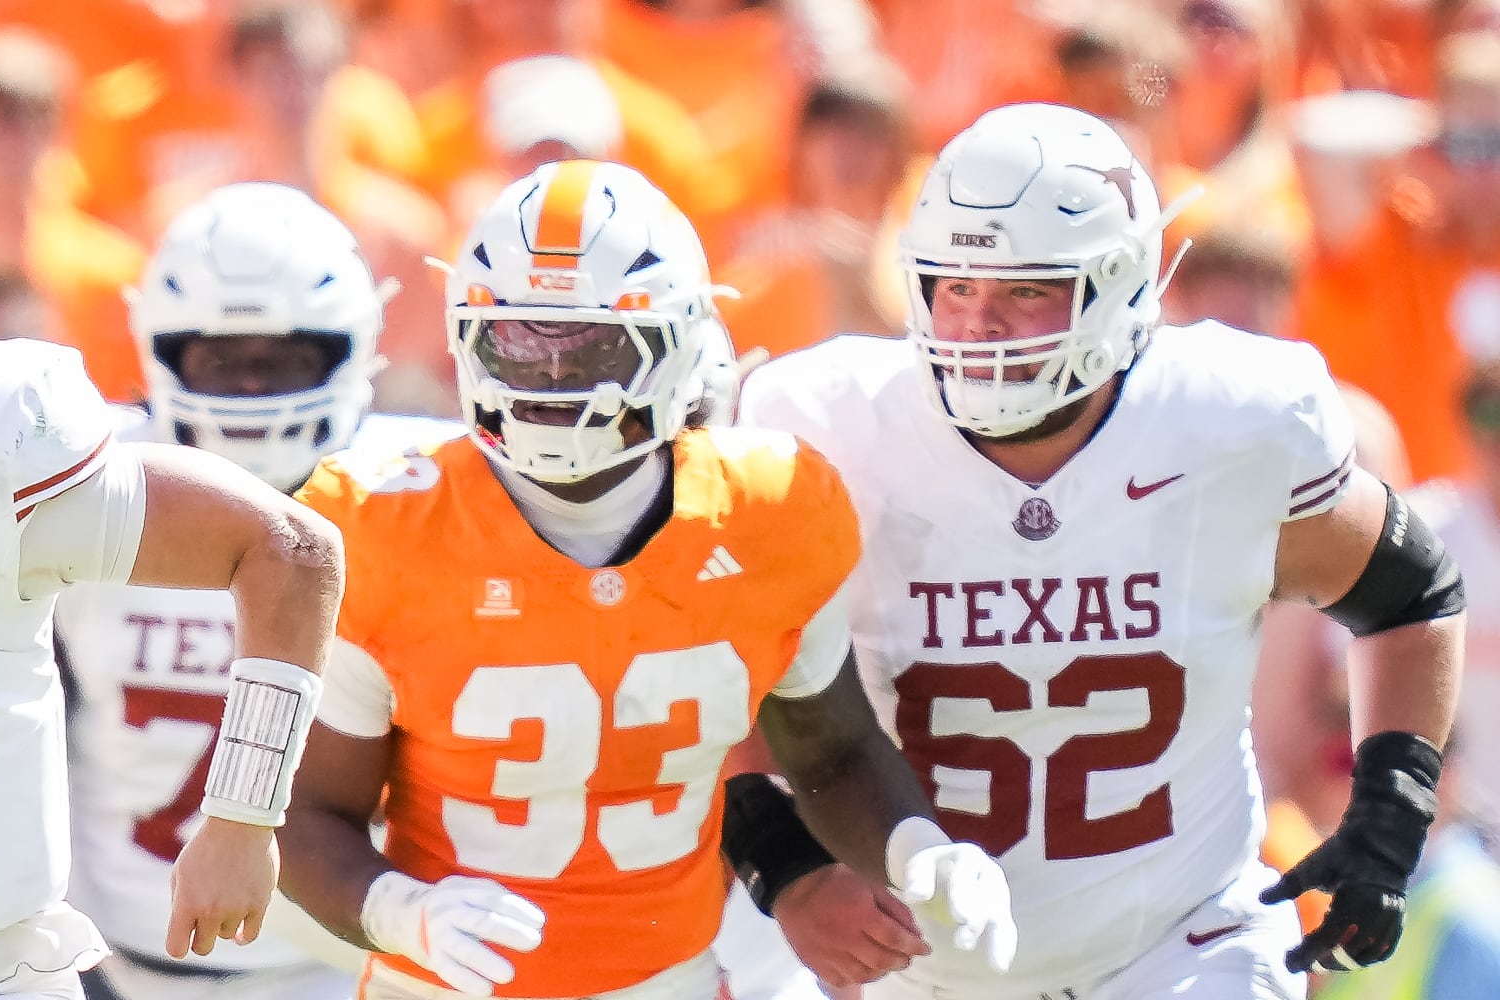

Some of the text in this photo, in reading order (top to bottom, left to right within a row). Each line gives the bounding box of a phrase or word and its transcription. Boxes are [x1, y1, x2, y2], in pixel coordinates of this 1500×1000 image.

[908, 571, 1162, 649] TEXAS
[441, 640, 751, 879] 33
[893, 650, 1188, 861] 62
